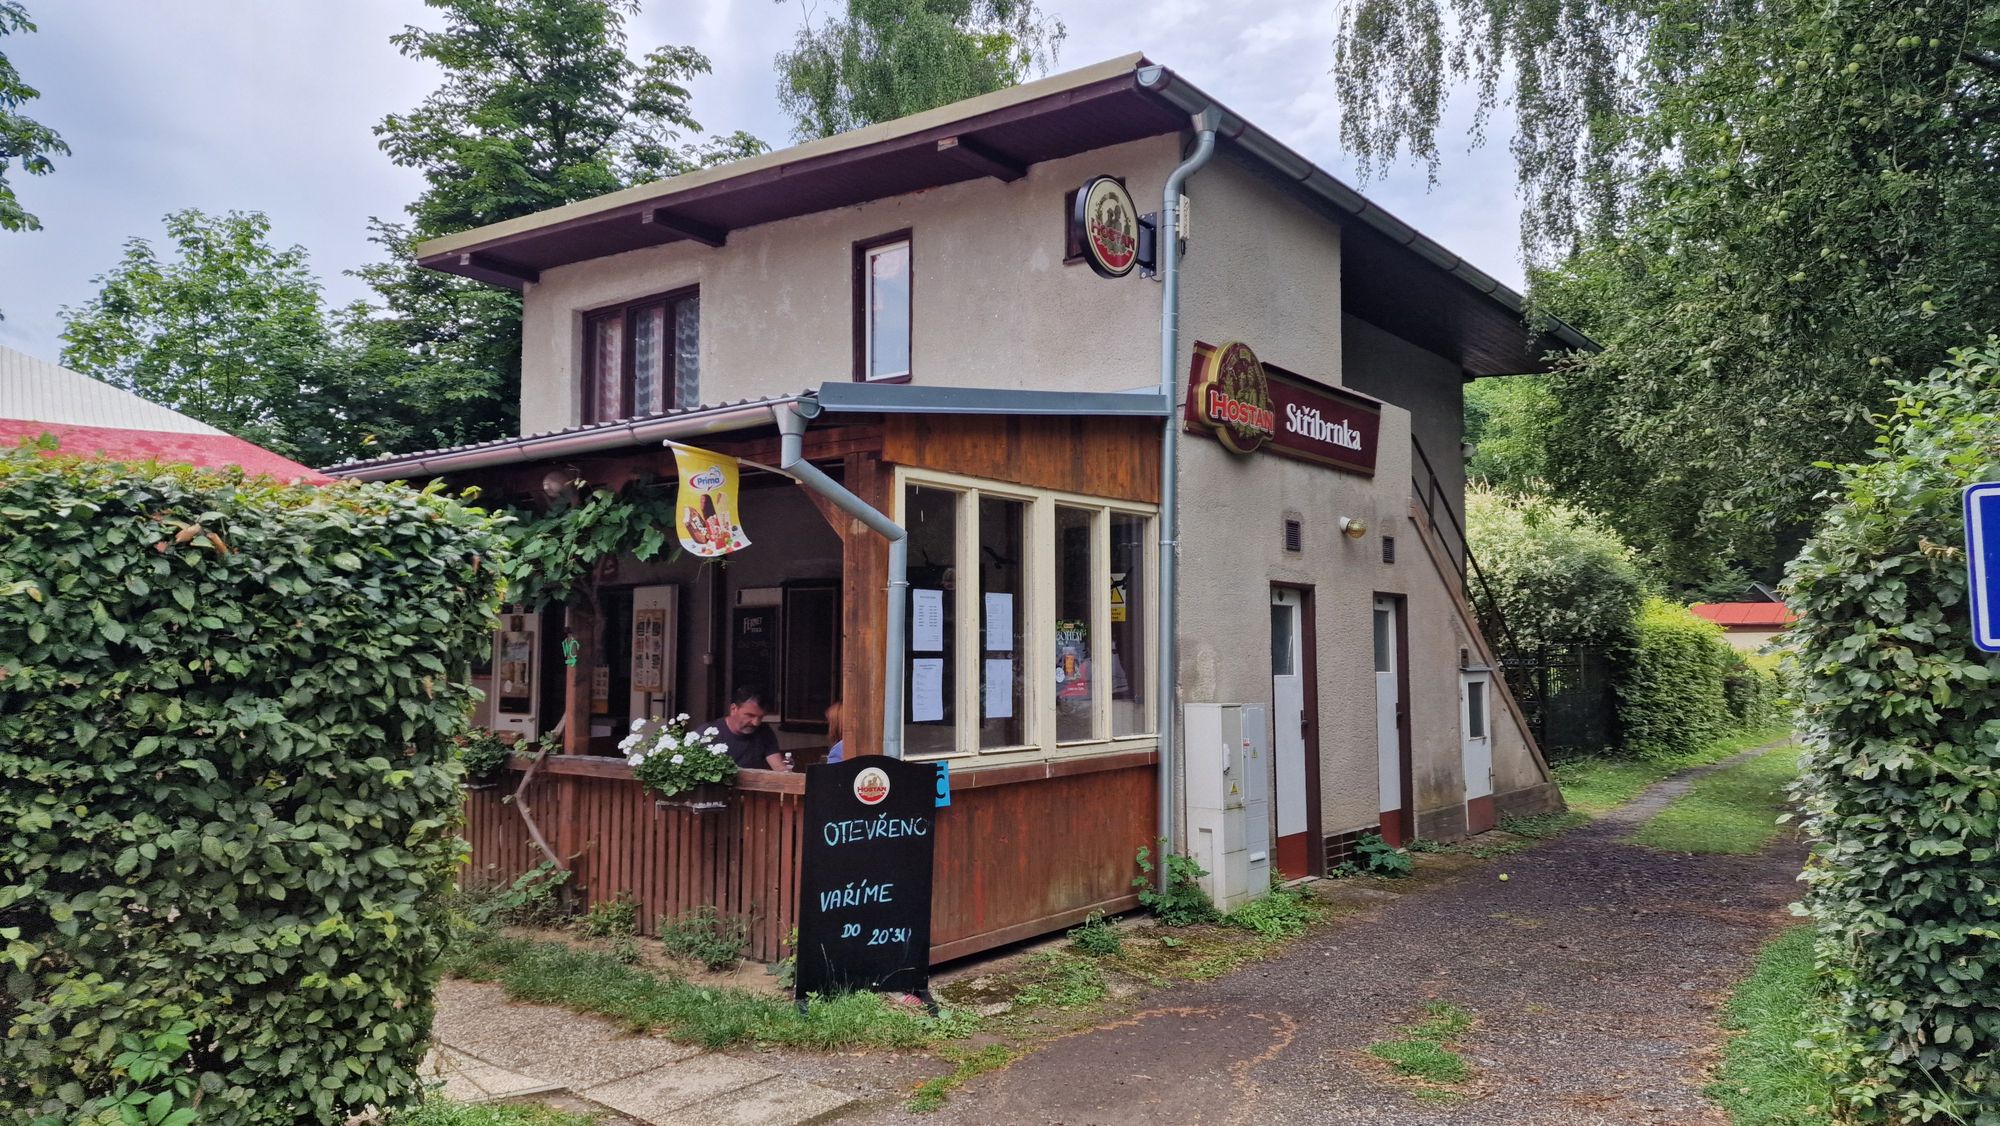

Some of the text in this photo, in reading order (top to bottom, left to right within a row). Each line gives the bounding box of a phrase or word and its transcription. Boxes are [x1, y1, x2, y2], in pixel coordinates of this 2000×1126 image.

[1090, 216, 1136, 251] HOSTAN
[1210, 389, 1275, 434] HOSTAN
[1286, 402, 1362, 451] Stříbrnka
[697, 476, 720, 486] Prima
[562, 638, 580, 658] WC
[824, 812, 928, 846] OTEVŘENO
[820, 879, 894, 912] VAŘÍME
[841, 923, 861, 938] DO
